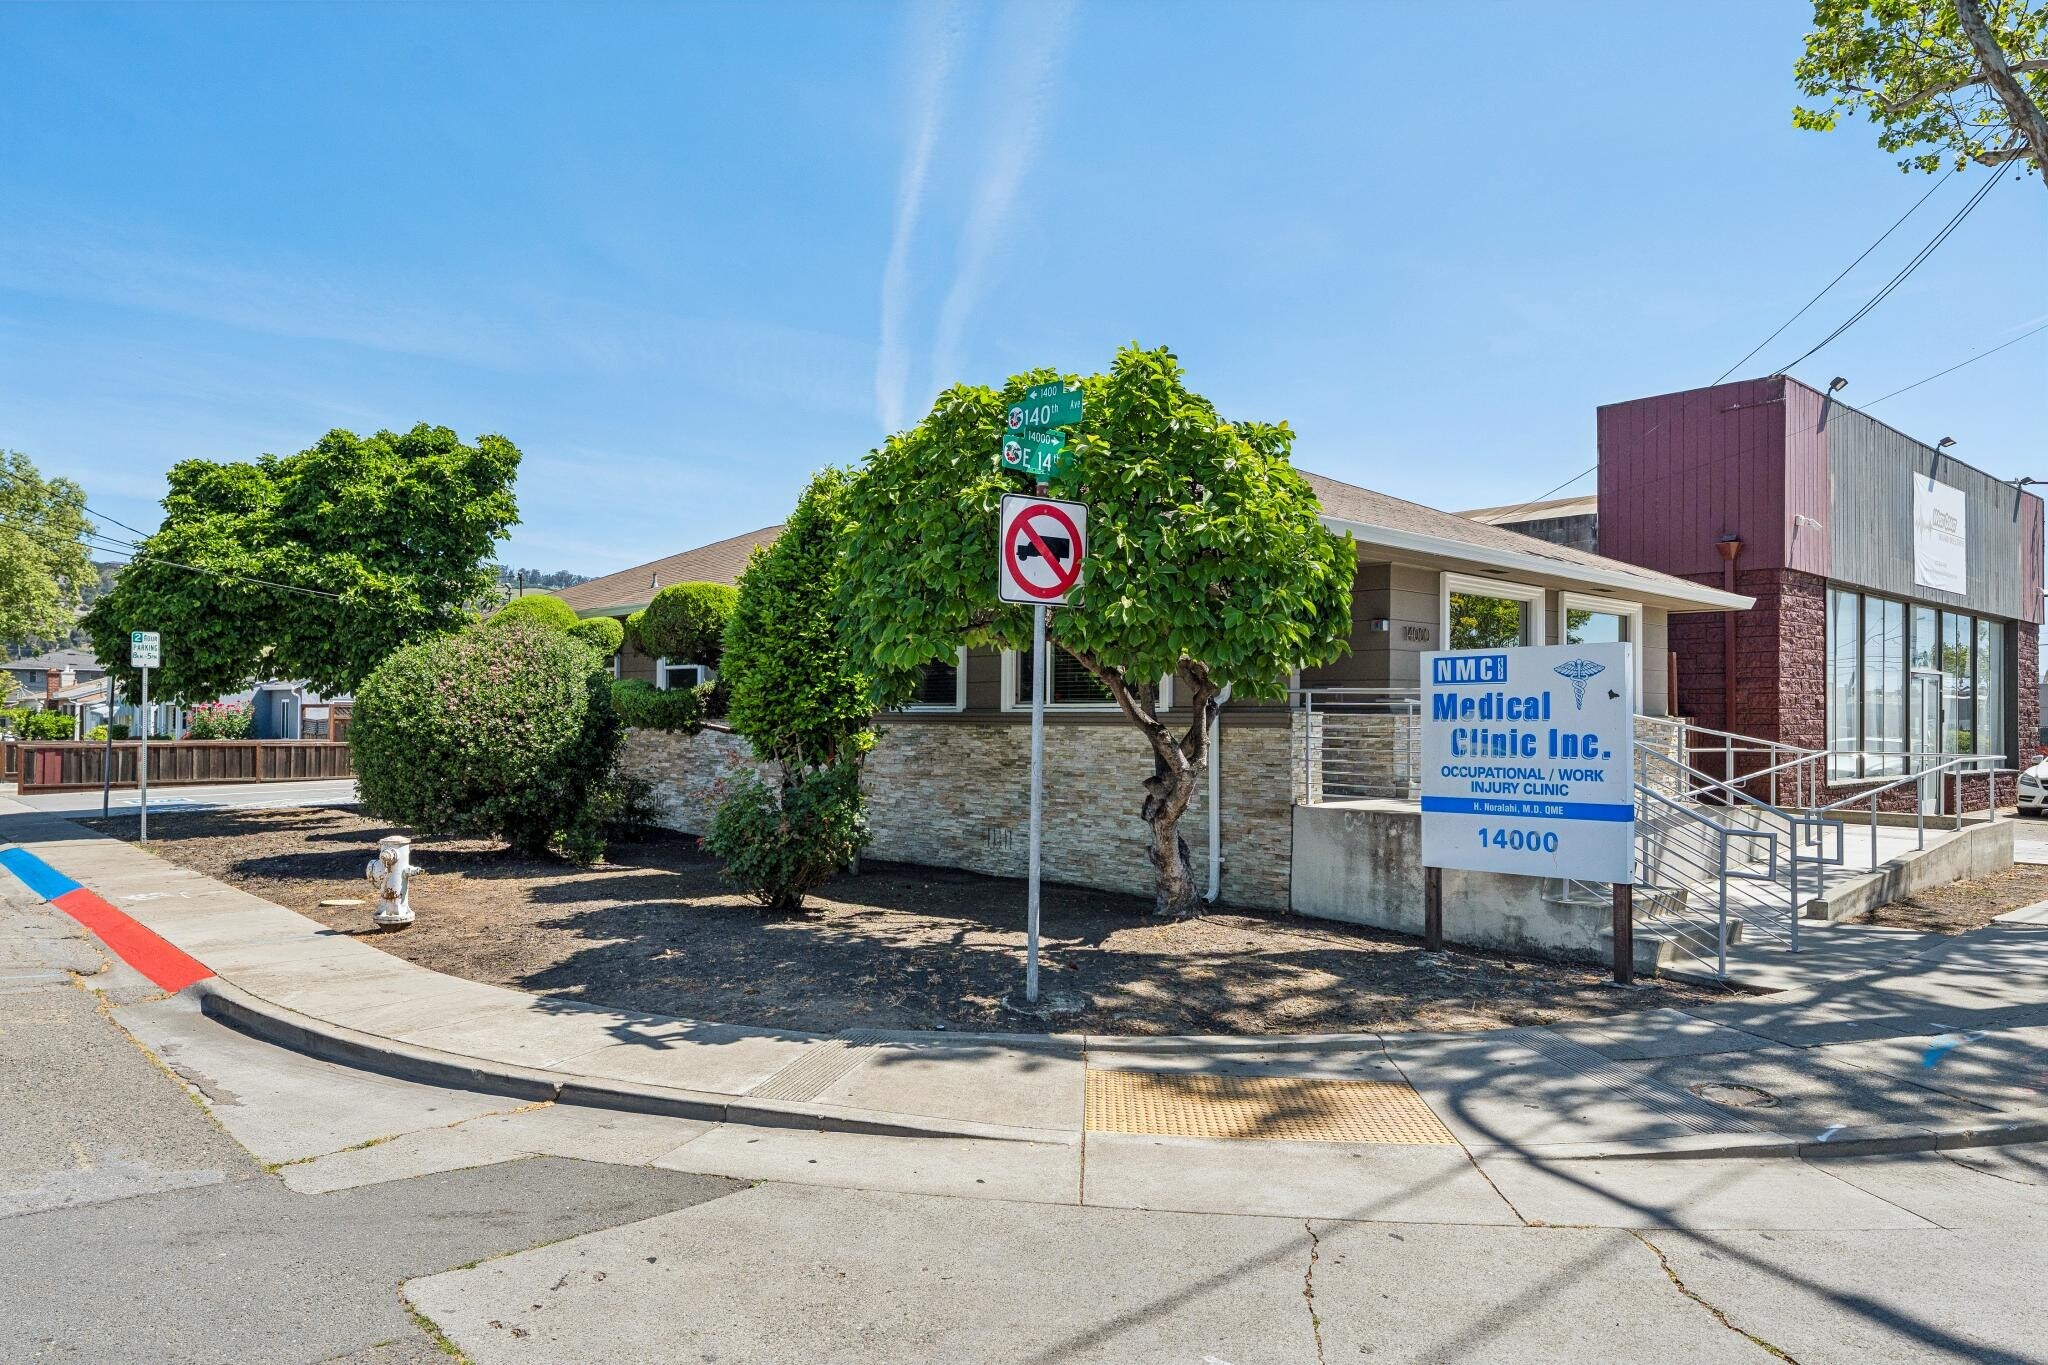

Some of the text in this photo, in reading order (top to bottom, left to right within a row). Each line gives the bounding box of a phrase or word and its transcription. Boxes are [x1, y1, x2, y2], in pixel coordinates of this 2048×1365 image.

[1041, 386, 1057, 397] 1400
[1025, 404, 1059, 426] 140th
[1028, 430, 1051, 444] 14000
[1022, 447, 1031, 468] E
[134, 633, 141, 642] 2
[1432, 691, 1551, 722] Medical
[1451, 728, 1612, 760] Clinic Inc.
[1441, 765, 1545, 780] OCCUPATIONAL
[1558, 768, 1604, 782] WORK
[1471, 781, 1569, 796] INJURY CLINIC
[1473, 802, 1482, 811] H.
[1522, 804, 1542, 814] M.D.
[1544, 805, 1564, 815] QME
[1478, 828, 1559, 852] 14000
